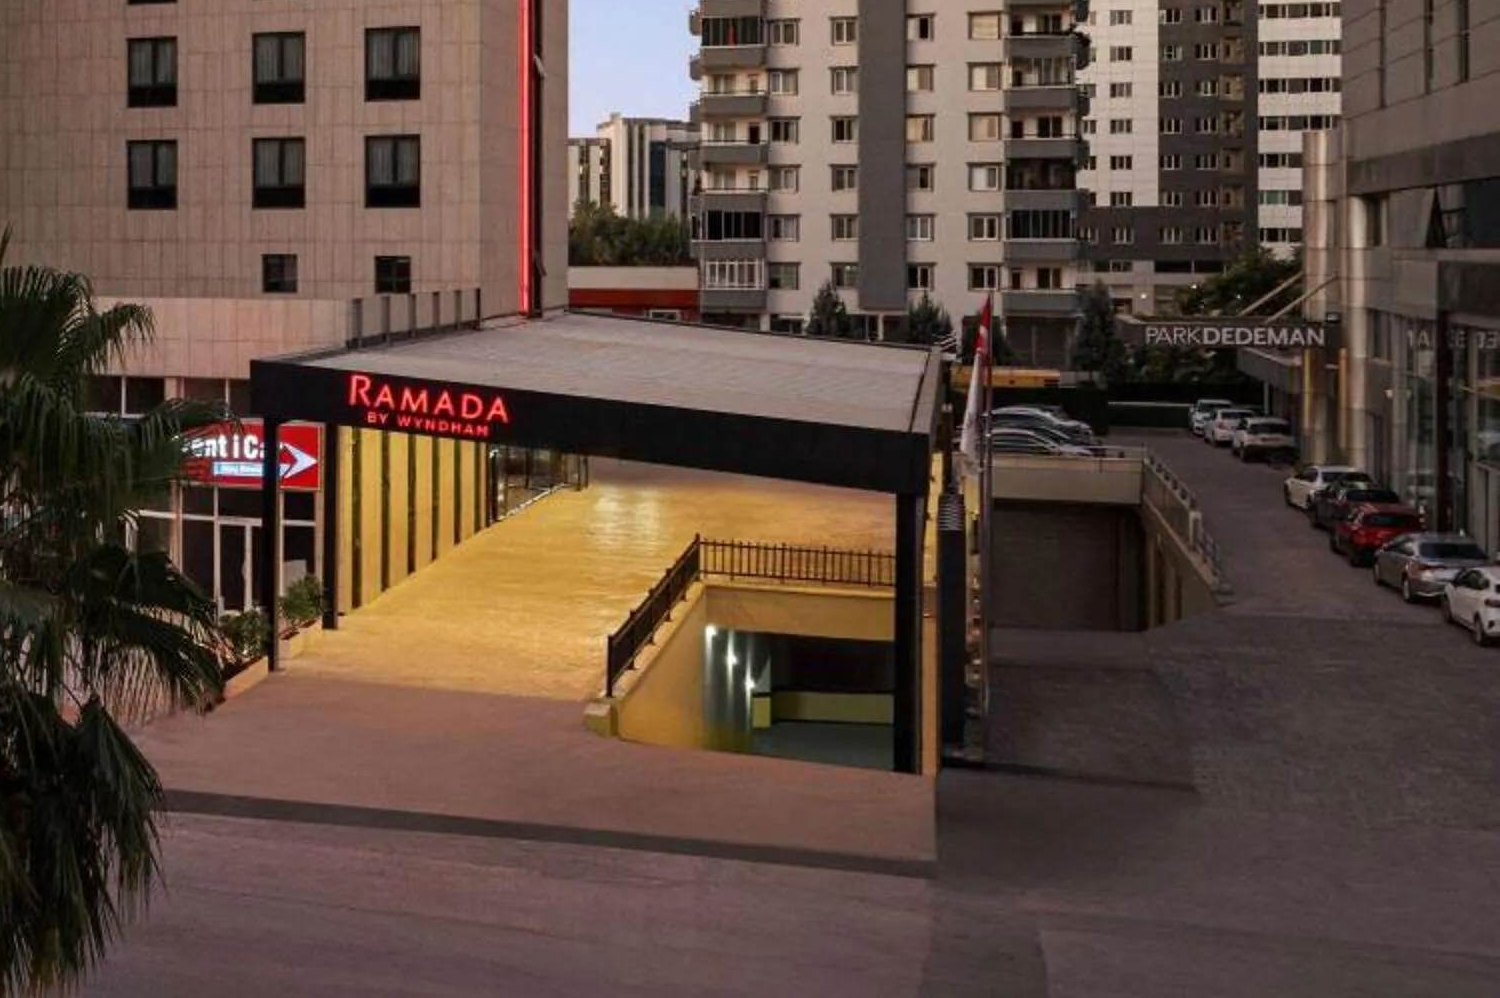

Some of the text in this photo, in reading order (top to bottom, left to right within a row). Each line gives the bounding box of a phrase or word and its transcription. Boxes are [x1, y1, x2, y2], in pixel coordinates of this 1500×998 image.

[348, 374, 509, 424] RAMADA
[367, 411, 489, 437] BY WYNDHAM
